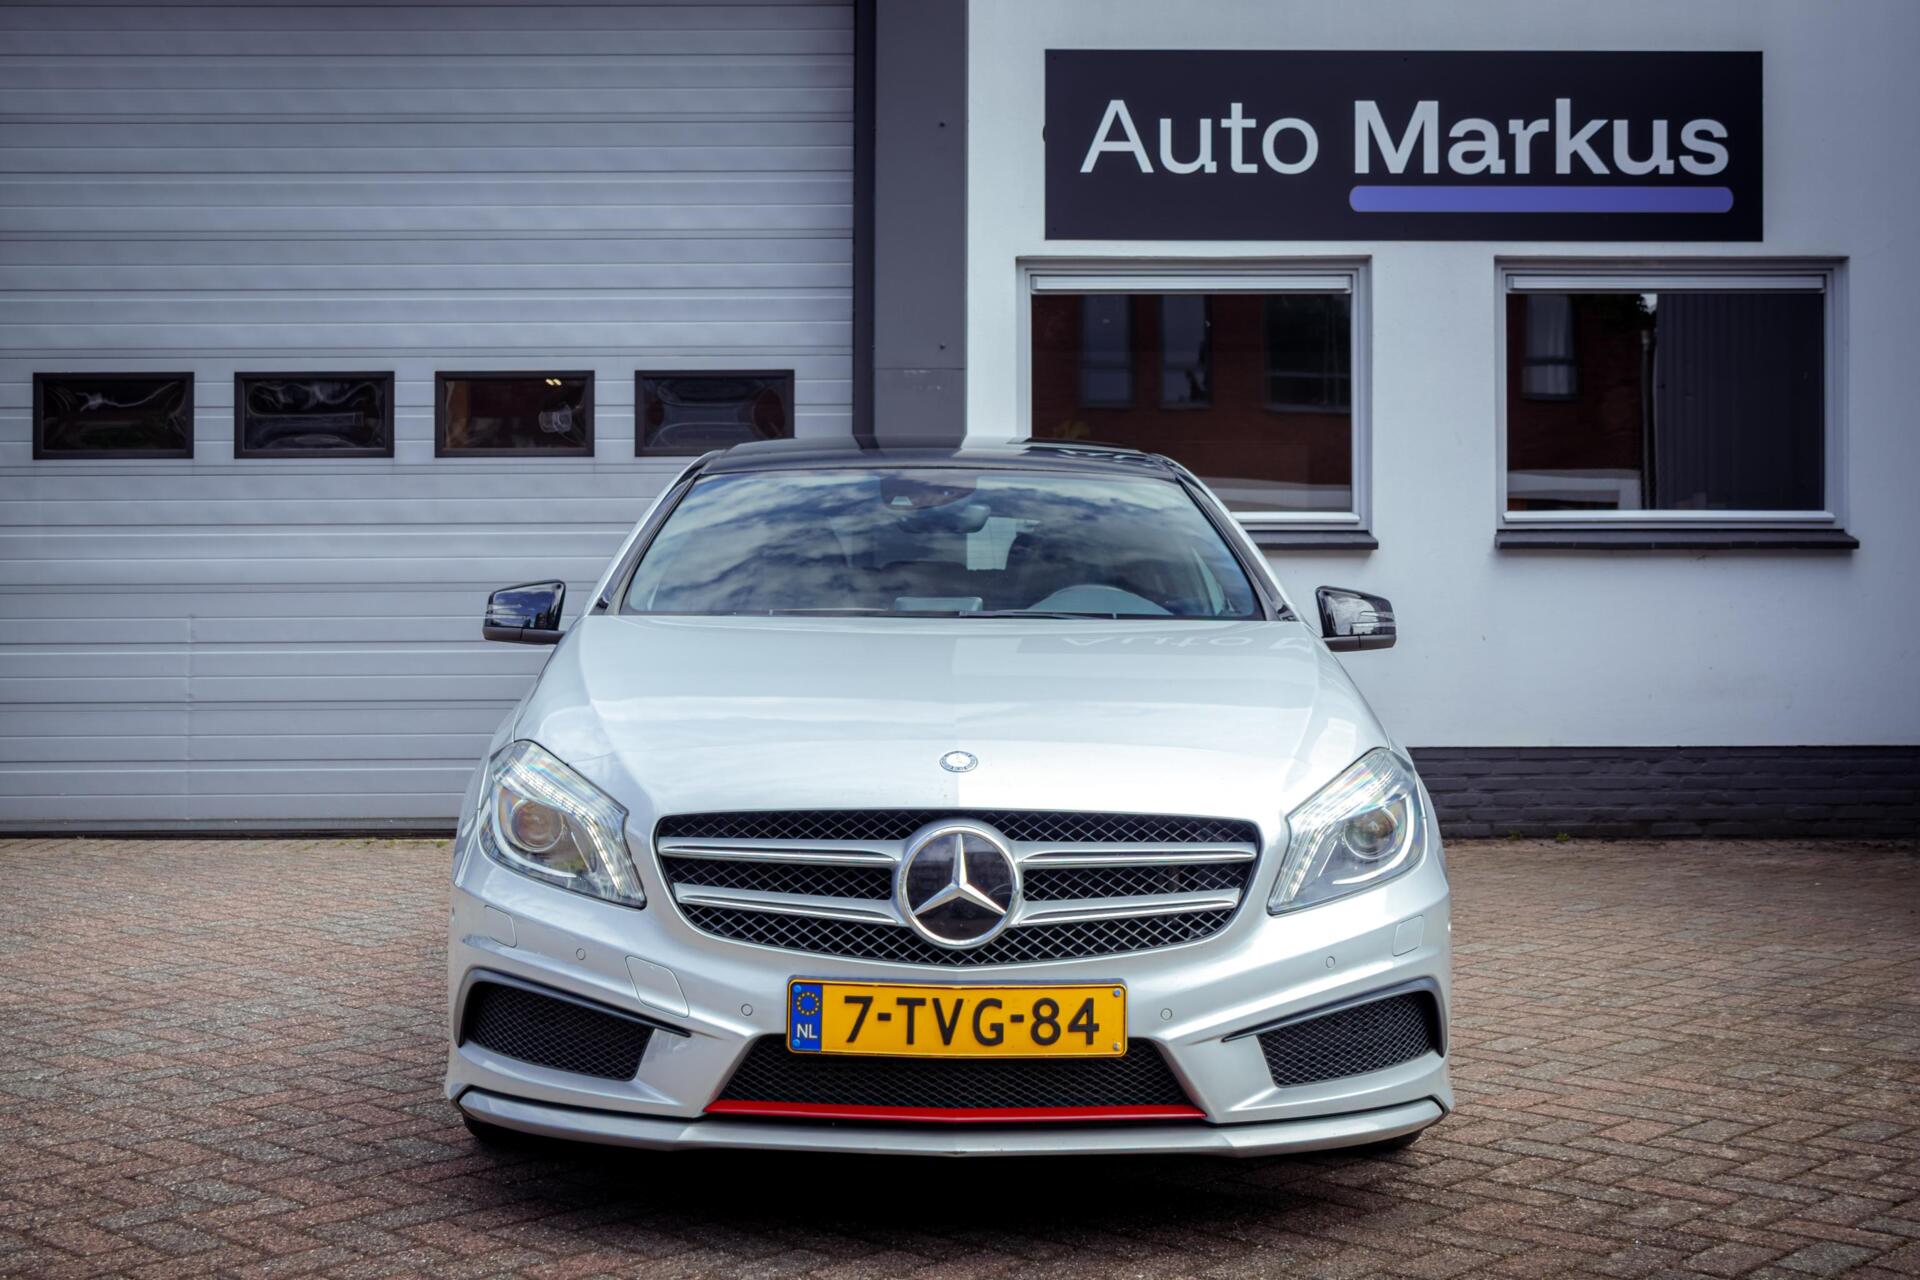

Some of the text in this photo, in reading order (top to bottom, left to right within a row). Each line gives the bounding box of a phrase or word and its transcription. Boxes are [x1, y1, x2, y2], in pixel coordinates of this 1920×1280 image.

[1080, 98, 1729, 175] Auto Markus
[796, 1023, 818, 1039] NL
[844, 995, 1099, 1046] 7-TVG-84
